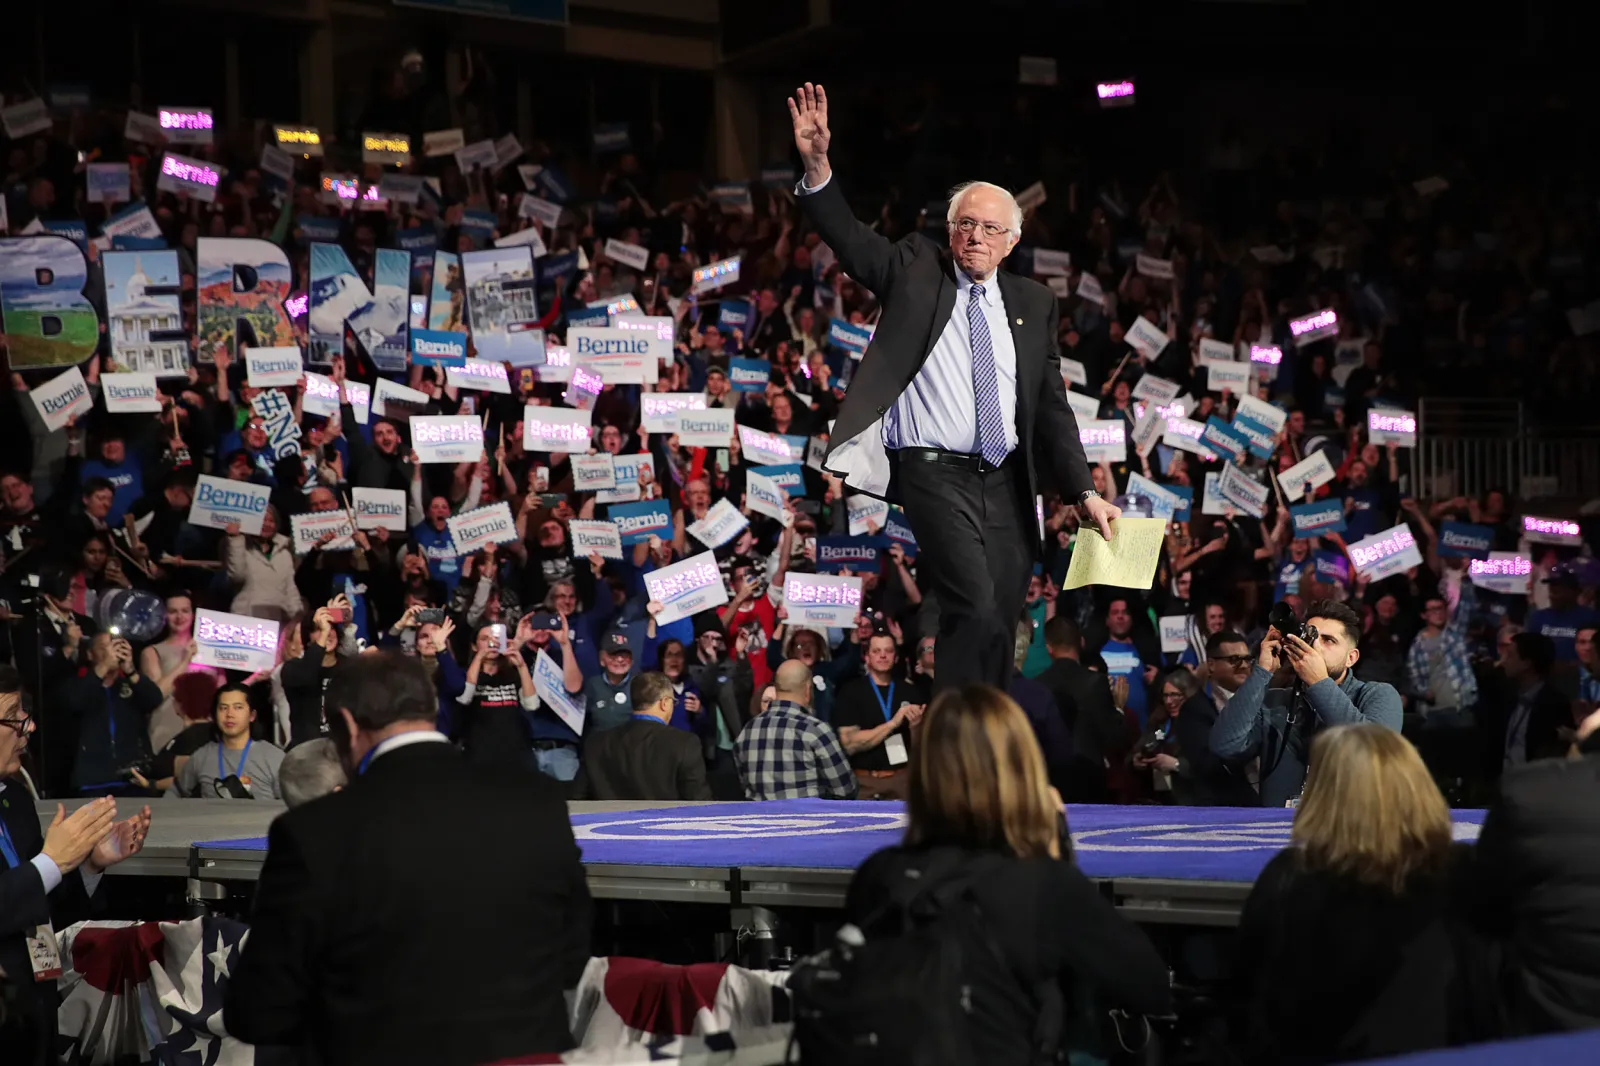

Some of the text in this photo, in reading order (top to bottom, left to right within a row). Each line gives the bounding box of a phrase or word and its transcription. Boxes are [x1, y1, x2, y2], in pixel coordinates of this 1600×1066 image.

[160, 110, 213, 130] Bernie
[277, 129, 320, 145] Bernie
[364, 136, 409, 153] Bernie
[162, 156, 219, 187] Bernie
[1289, 310, 1338, 337] Bernie
[414, 337, 463, 357] Bernie
[577, 334, 649, 356] Bernie
[251, 357, 298, 374] Bernie
[731, 365, 770, 382] Bernie
[41, 382, 85, 414] Bernie
[108, 384, 154, 399] Bernie
[415, 420, 483, 442] Bernie
[530, 419, 590, 441] Bernie
[681, 418, 730, 433] Bernie
[1370, 412, 1416, 432] Bernie
[742, 428, 791, 457] Bernie
[1079, 425, 1126, 445] ernie
[577, 467, 611, 479] Bernie
[199, 483, 267, 513] Bernie
[356, 500, 403, 516] Bernie
[614, 510, 669, 533] Bernie
[1294, 509, 1342, 529] Bernie
[1523, 516, 1580, 536] Bernie
[457, 518, 508, 542] Bernie
[578, 533, 617, 547] Bernie
[1442, 530, 1489, 550] Bernie
[820, 545, 876, 560] Bernie
[1352, 531, 1414, 568] Bernie
[1471, 556, 1532, 576] Bernie
[650, 562, 717, 601] Bernie
[788, 579, 862, 606] Bernie
[199, 616, 278, 649] Bernie
[214, 649, 249, 661] Bernie
